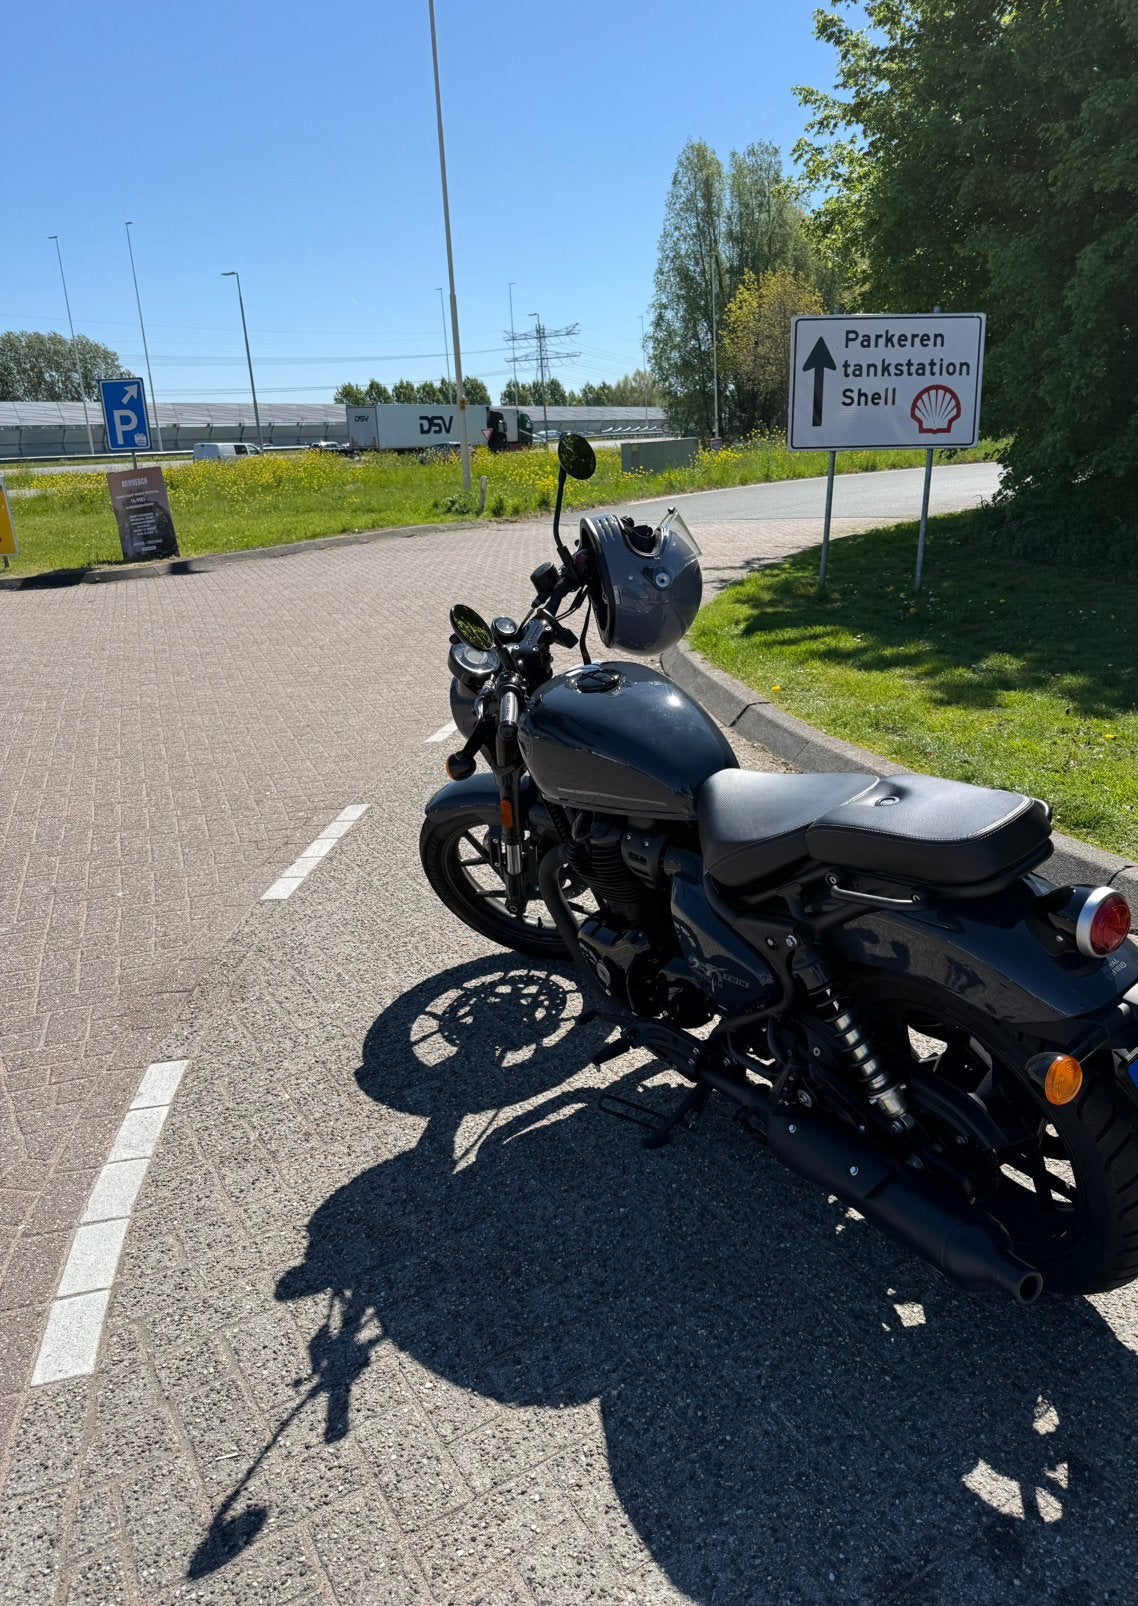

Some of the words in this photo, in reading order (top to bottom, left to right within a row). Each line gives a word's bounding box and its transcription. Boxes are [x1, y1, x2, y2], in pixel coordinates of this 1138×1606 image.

[845, 329, 945, 349] Parkeren
[841, 358, 970, 378] tankstation
[841, 387, 897, 406] Shell
[113, 410, 138, 445] P
[419, 415, 454, 435] DSV
